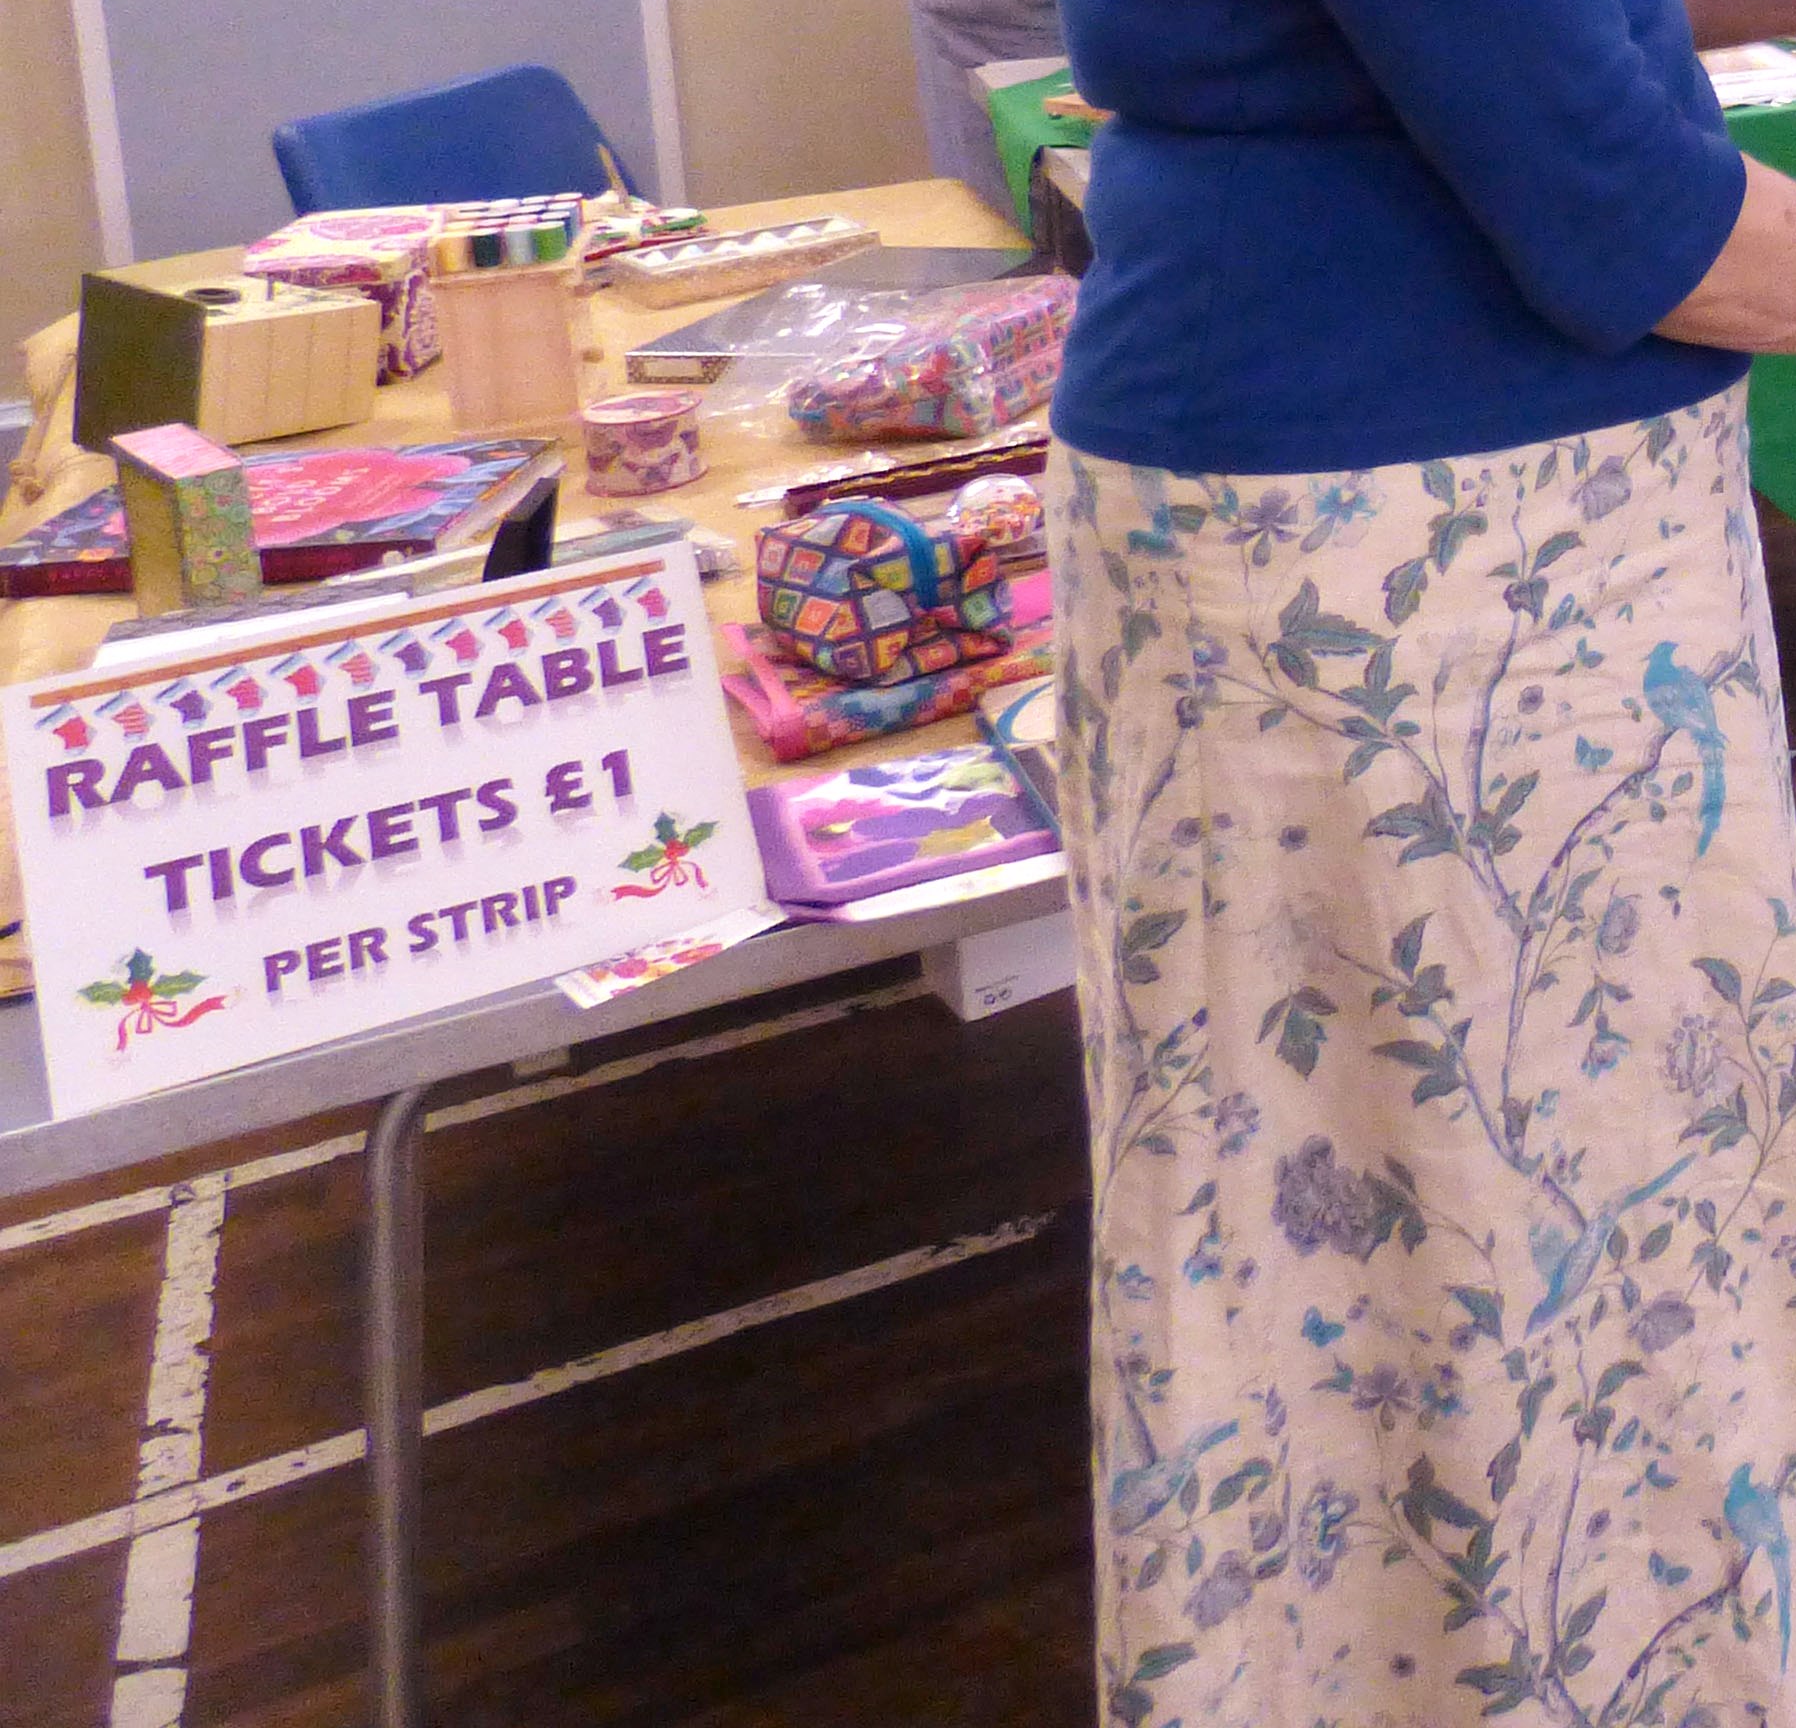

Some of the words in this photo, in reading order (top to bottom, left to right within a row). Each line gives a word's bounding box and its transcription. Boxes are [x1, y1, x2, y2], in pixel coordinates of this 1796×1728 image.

[46, 689, 400, 818] RAFFLE
[419, 623, 691, 727] TABLE
[144, 778, 519, 912] TICKETS
[545, 749, 634, 813] £1
[264, 927, 389, 993] PER
[407, 875, 578, 954] STRIP
